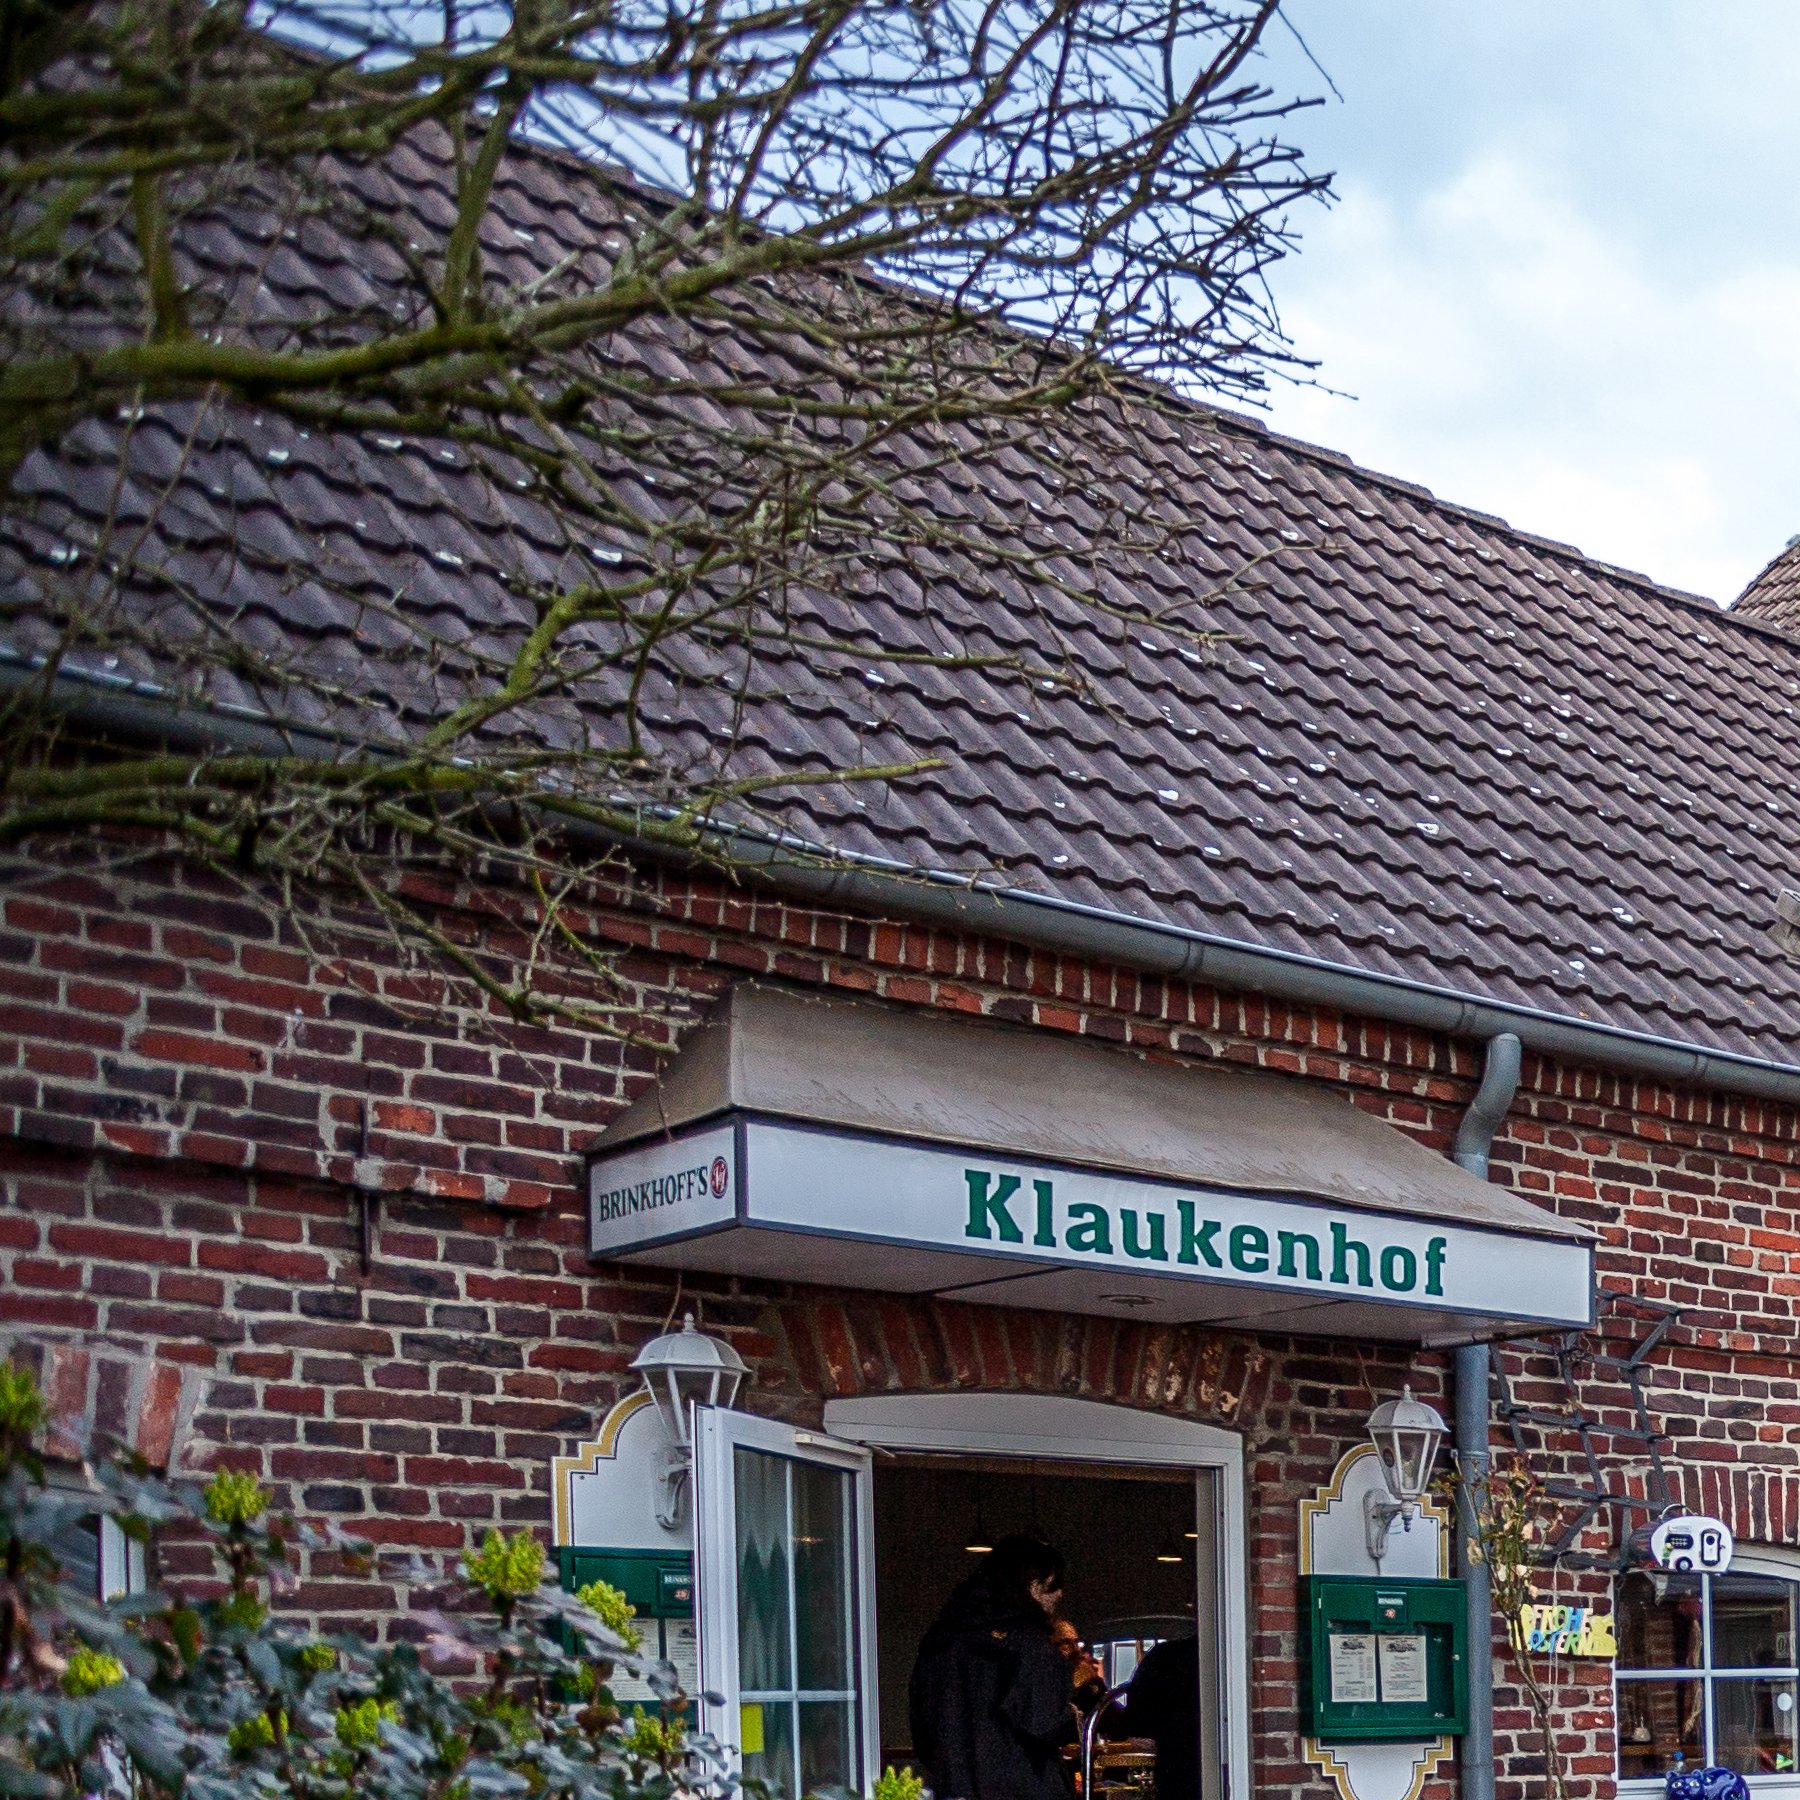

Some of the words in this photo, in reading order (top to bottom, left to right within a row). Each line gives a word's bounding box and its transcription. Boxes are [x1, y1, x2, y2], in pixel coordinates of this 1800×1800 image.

[599, 1166, 708, 1222] BRINKHOFF'S
[964, 1169, 1447, 1296] Klaukenhof
[1533, 1604, 1593, 1633] FROHE
[1530, 1630, 1594, 1656] OSTERN
